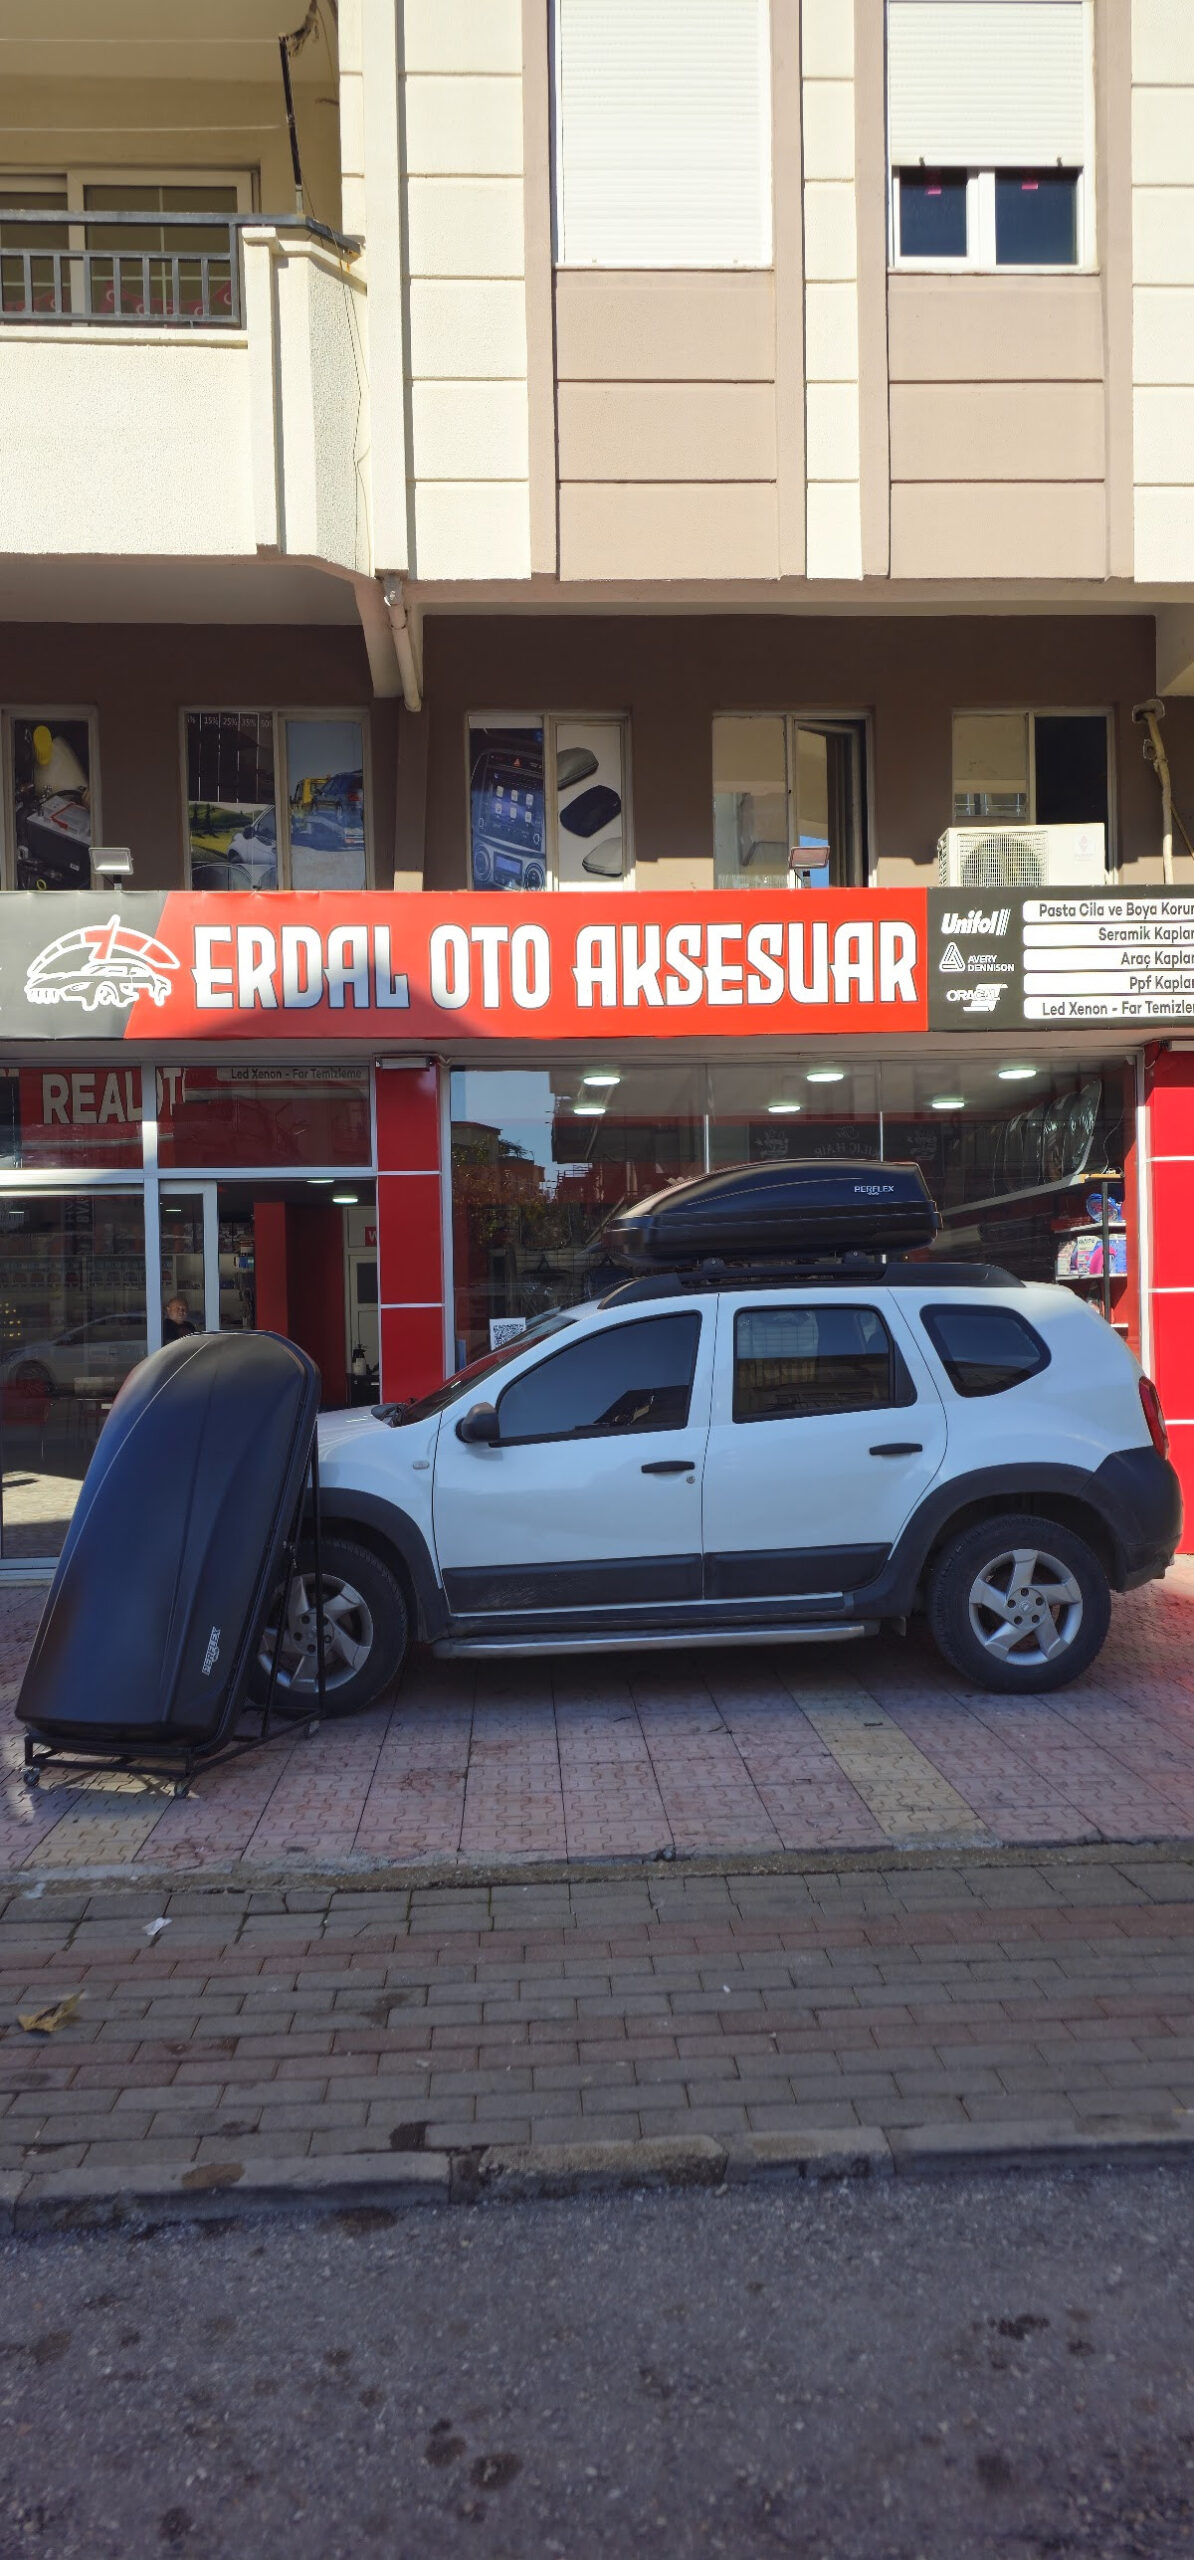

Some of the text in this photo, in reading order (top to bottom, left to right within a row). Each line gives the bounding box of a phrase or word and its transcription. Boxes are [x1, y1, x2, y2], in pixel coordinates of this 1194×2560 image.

[1039, 903, 1076, 917] Pasta
[1079, 902, 1104, 916] Cila
[1108, 905, 1122, 915] ve
[1126, 902, 1157, 919] Boya
[1098, 926, 1151, 941] Seramik
[190, 921, 919, 1010] ERDAL OTO AKSESUAR
[968, 955, 997, 963] AVERY
[968, 963, 1015, 972] DENNISON
[1121, 951, 1151, 968] Araç
[1129, 975, 1152, 993] Ppf
[1042, 1002, 1065, 1016] Led
[1068, 1001, 1108, 1015] Xenon
[1122, 1001, 1142, 1014] Far
[1145, 999, 1194, 1014] Temizle
[231, 1068, 249, 1079] Led
[251, 1068, 282, 1079] Xenon
[292, 1068, 308, 1079] Far
[42, 1071, 143, 1124] REAL
[854, 1185, 894, 1193] PERFLEX
